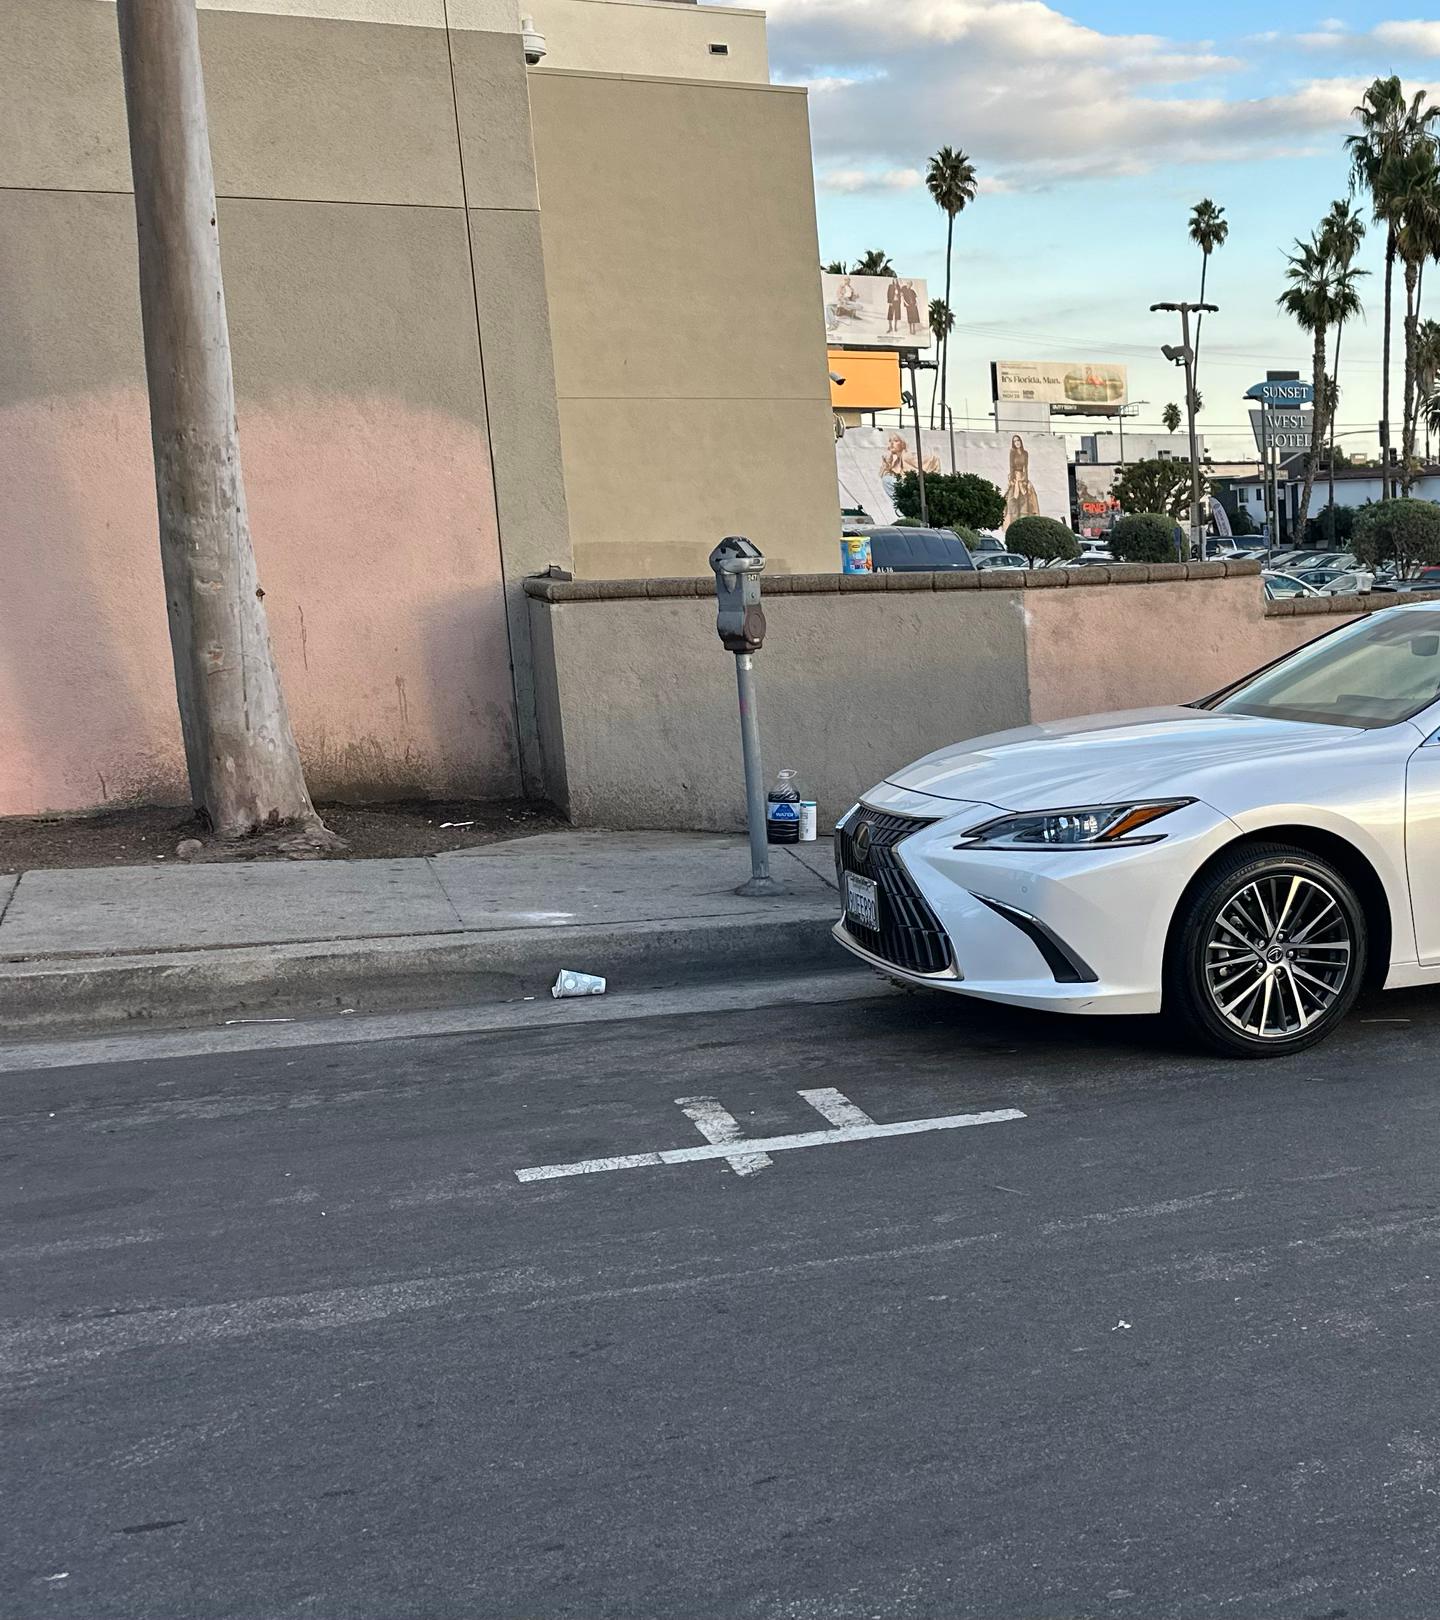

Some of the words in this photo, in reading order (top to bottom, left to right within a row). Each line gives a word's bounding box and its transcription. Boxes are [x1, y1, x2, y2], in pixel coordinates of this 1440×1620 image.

[1001, 375, 1013, 383] It's
[1013, 376, 1041, 385] Florida,
[1262, 386, 1309, 399] SUNSET
[1267, 415, 1307, 428] WEST
[1265, 433, 1313, 447] HOTEL
